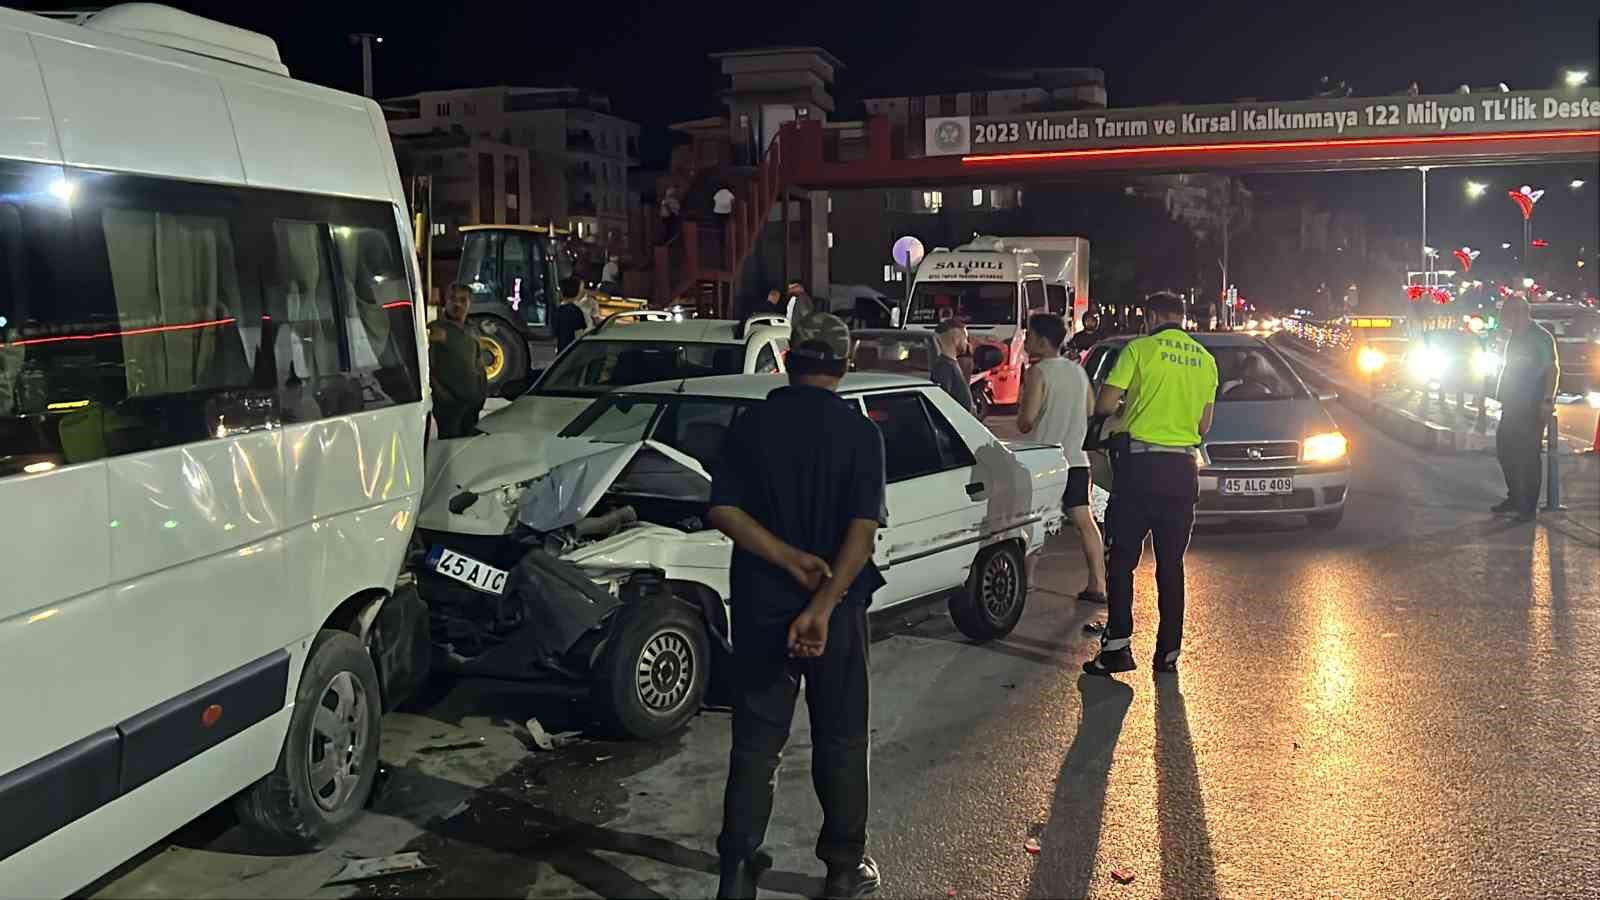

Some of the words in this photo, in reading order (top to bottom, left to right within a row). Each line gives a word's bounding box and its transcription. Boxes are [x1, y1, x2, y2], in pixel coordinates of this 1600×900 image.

[975, 122, 1019, 143] 2023
[1026, 117, 1089, 141] Yılında
[1095, 117, 1148, 138] Tarım
[1152, 119, 1176, 135] ve
[1182, 109, 1237, 134] Kırsal
[1243, 107, 1358, 133] Kalkınmaya
[1365, 104, 1400, 126] 122
[1407, 100, 1475, 129] Milyon
[1225, 479, 1241, 492] 45
[1244, 479, 1266, 492] ALG
[1269, 479, 1291, 491] 409
[440, 554, 467, 576] 45
